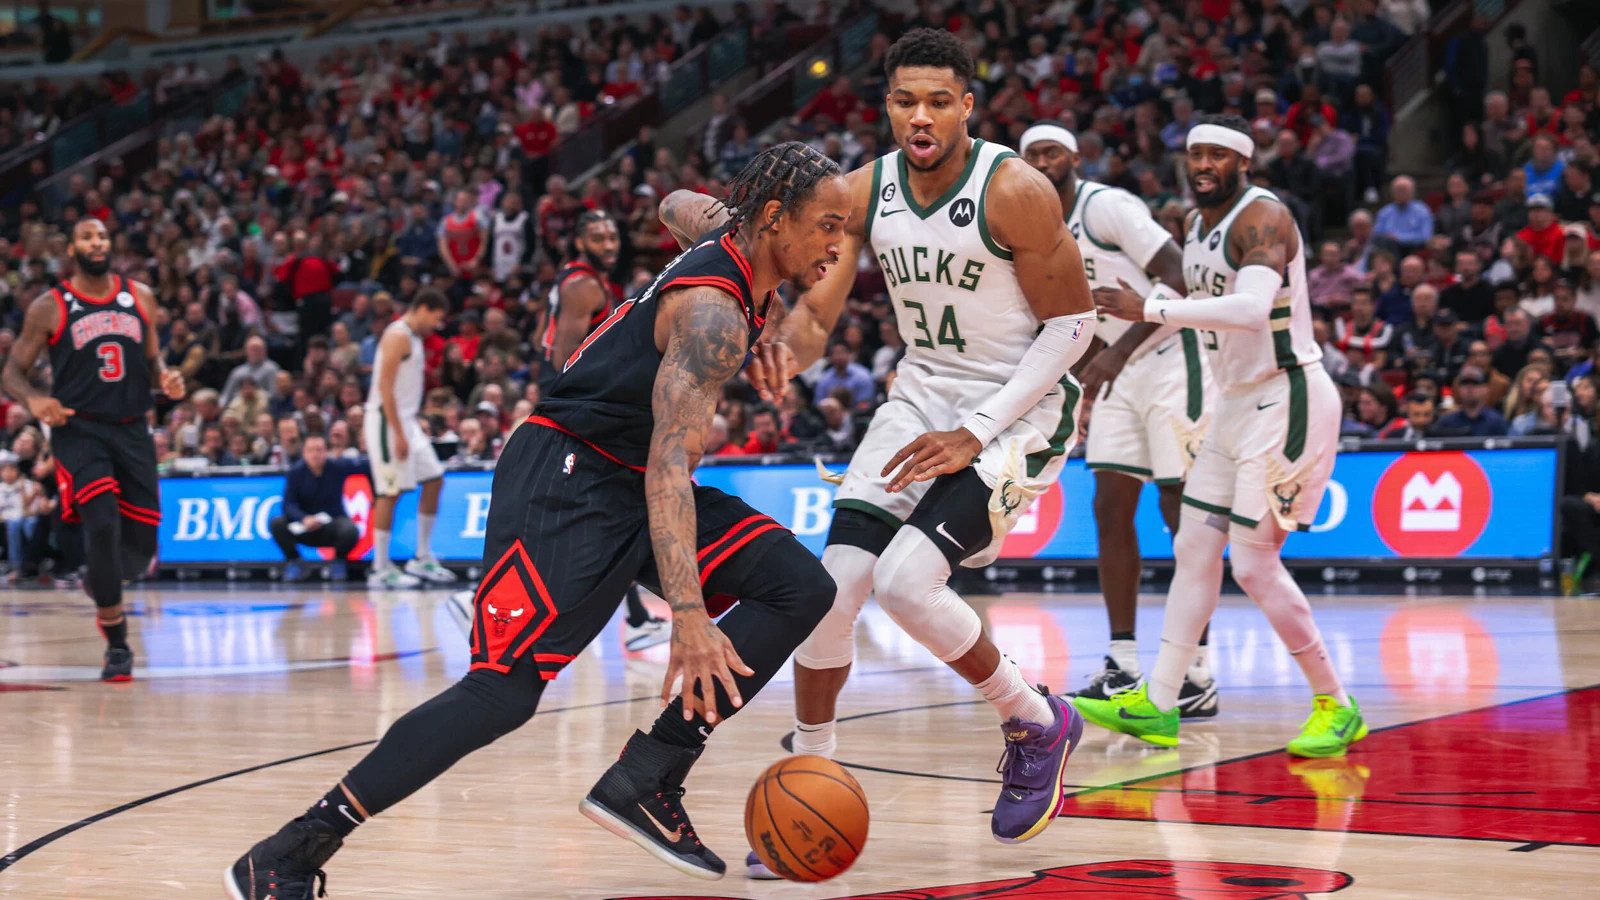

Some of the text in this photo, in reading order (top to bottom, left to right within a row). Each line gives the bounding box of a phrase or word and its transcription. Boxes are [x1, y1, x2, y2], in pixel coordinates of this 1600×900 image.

[879, 246, 986, 292] BUCKS
[70, 311, 142, 350] CHICAGO
[902, 298, 967, 353] 34
[96, 342, 125, 382] 3
